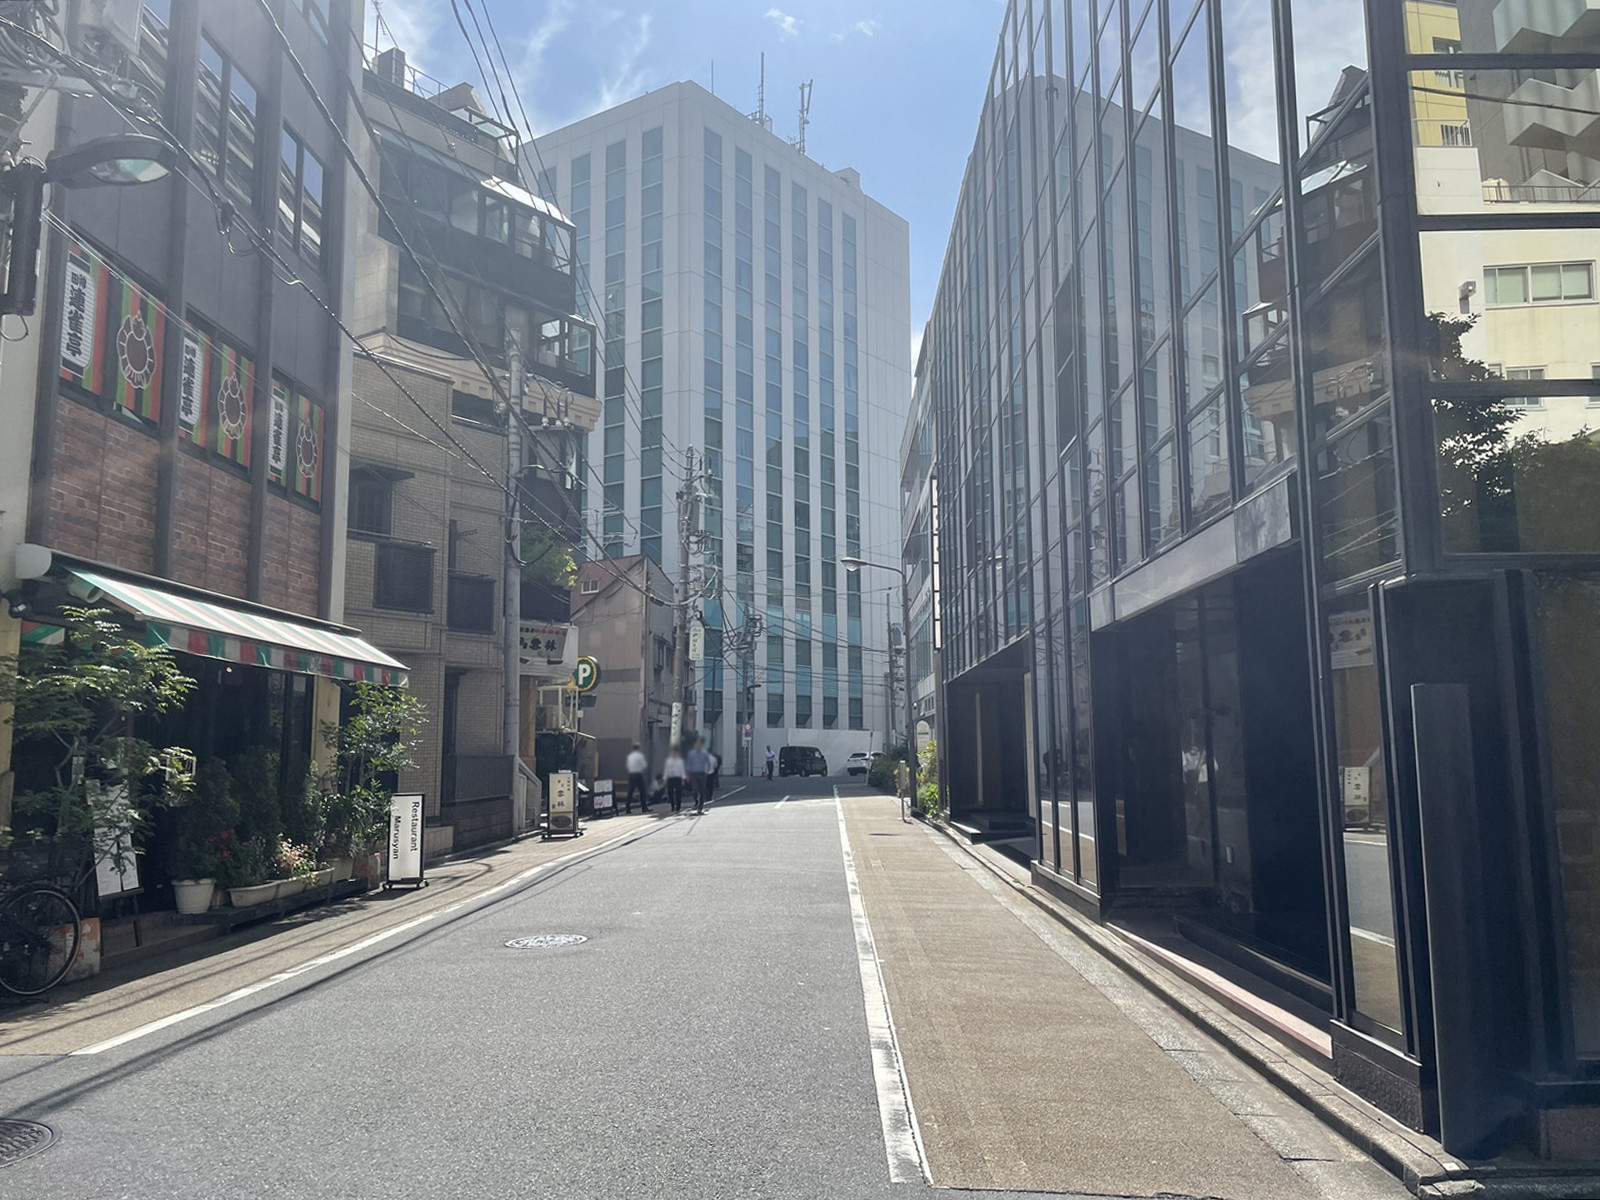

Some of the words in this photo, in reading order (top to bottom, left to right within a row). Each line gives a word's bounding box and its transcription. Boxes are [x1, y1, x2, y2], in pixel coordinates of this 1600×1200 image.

[579, 664, 591, 685] P
[391, 815, 402, 860] Marusyan
[410, 801, 420, 852] Restaurant
